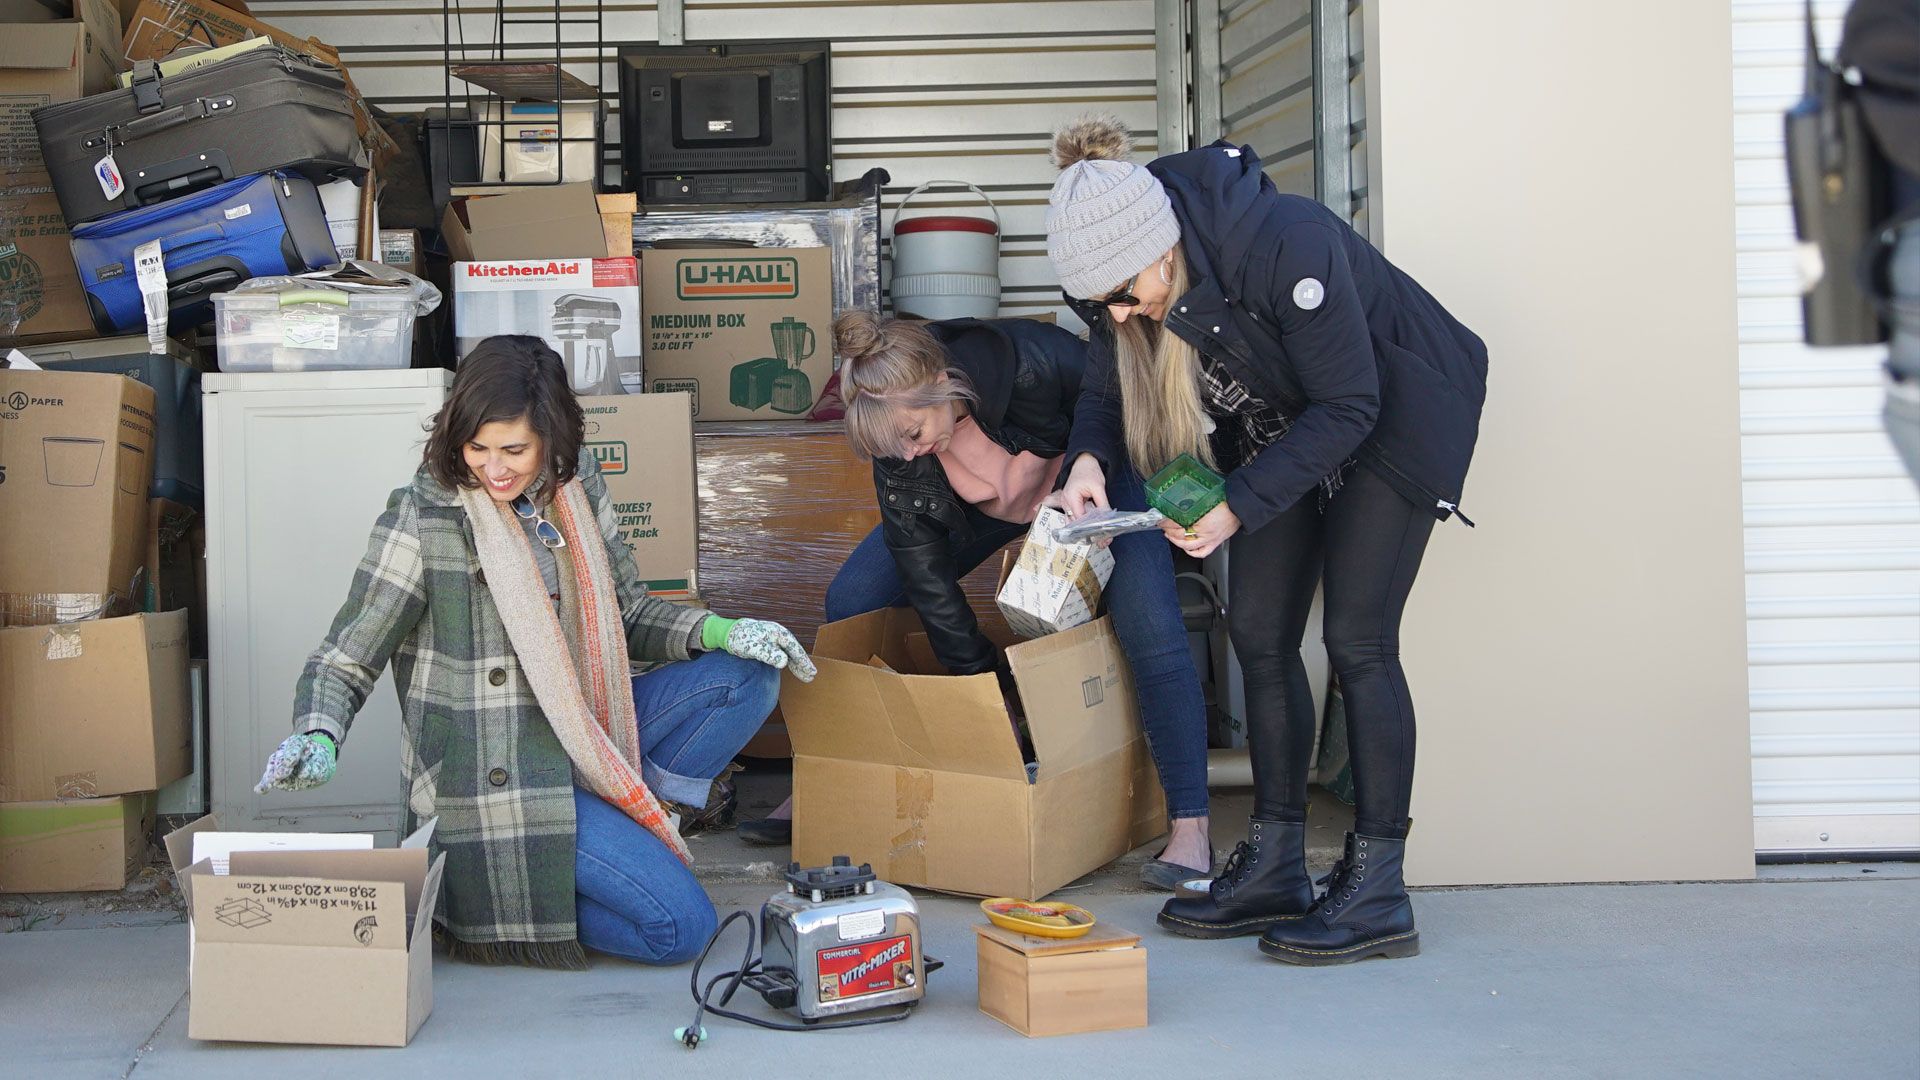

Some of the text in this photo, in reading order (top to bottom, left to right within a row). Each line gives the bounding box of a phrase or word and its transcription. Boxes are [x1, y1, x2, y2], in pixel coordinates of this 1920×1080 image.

[16, 186, 55, 195] HANDL
[37, 214, 65, 225] PLEN
[39, 226, 68, 236] Extra
[468, 262, 579, 277] KitchenAid
[685, 264, 791, 284] U-HAUL
[651, 313, 746, 329] MEDIUM BOX
[652, 341, 694, 351] 3.0 CU FT
[31, 397, 64, 406] PAPER
[585, 406, 618, 415] HANDLES
[0, 412, 19, 420] NESS
[618, 515, 651, 526] LENTY!
[1039, 511, 1051, 526] 283
[632, 527, 659, 538] Back
[1066, 545, 1081, 571] France
[252, 883, 266, 894] 12
[270, 883, 277, 892] x
[324, 886, 331, 894] x
[301, 898, 309, 906] x
[320, 899, 328, 909] 8
[331, 899, 339, 907] x
[341, 899, 349, 907] in
[823, 948, 861, 960] COMMERCIAL
[840, 940, 906, 986] VITA-MIXER
